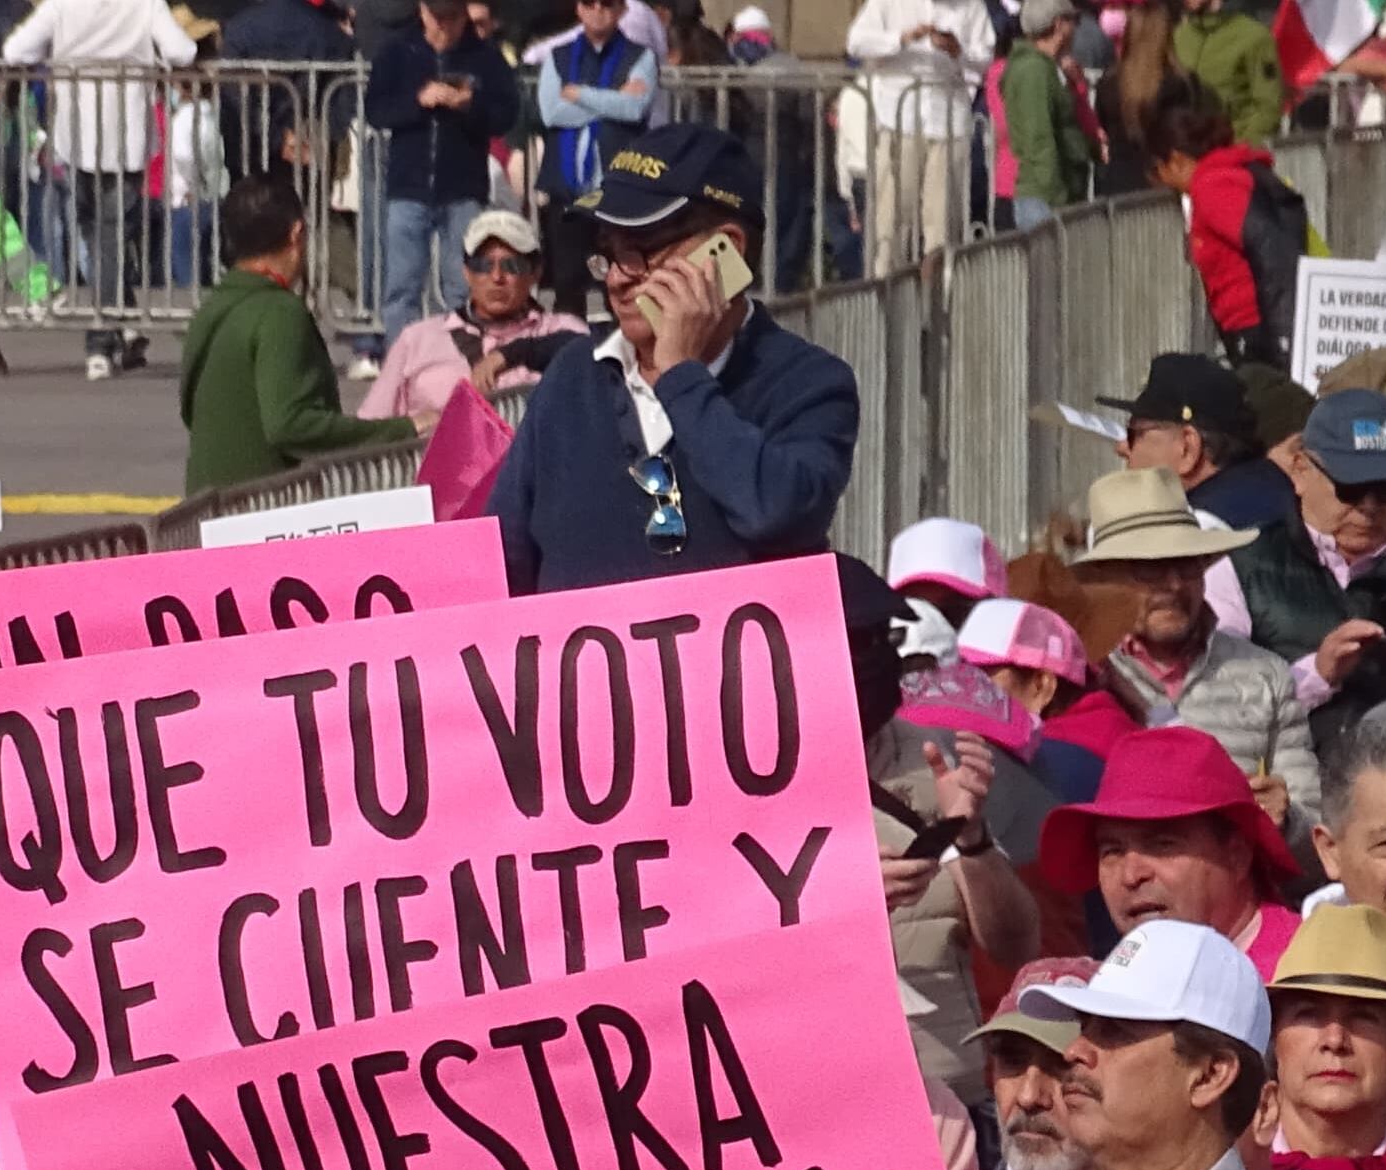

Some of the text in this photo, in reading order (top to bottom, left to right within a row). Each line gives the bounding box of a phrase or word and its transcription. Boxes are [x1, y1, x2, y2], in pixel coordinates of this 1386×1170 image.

[1319, 315, 1379, 334] DEFIENDE
[1320, 289, 1336, 305] LA
[264, 657, 428, 844] TU
[461, 602, 799, 824] VOTO
[22, 828, 829, 1093] SE CUENTE Y
